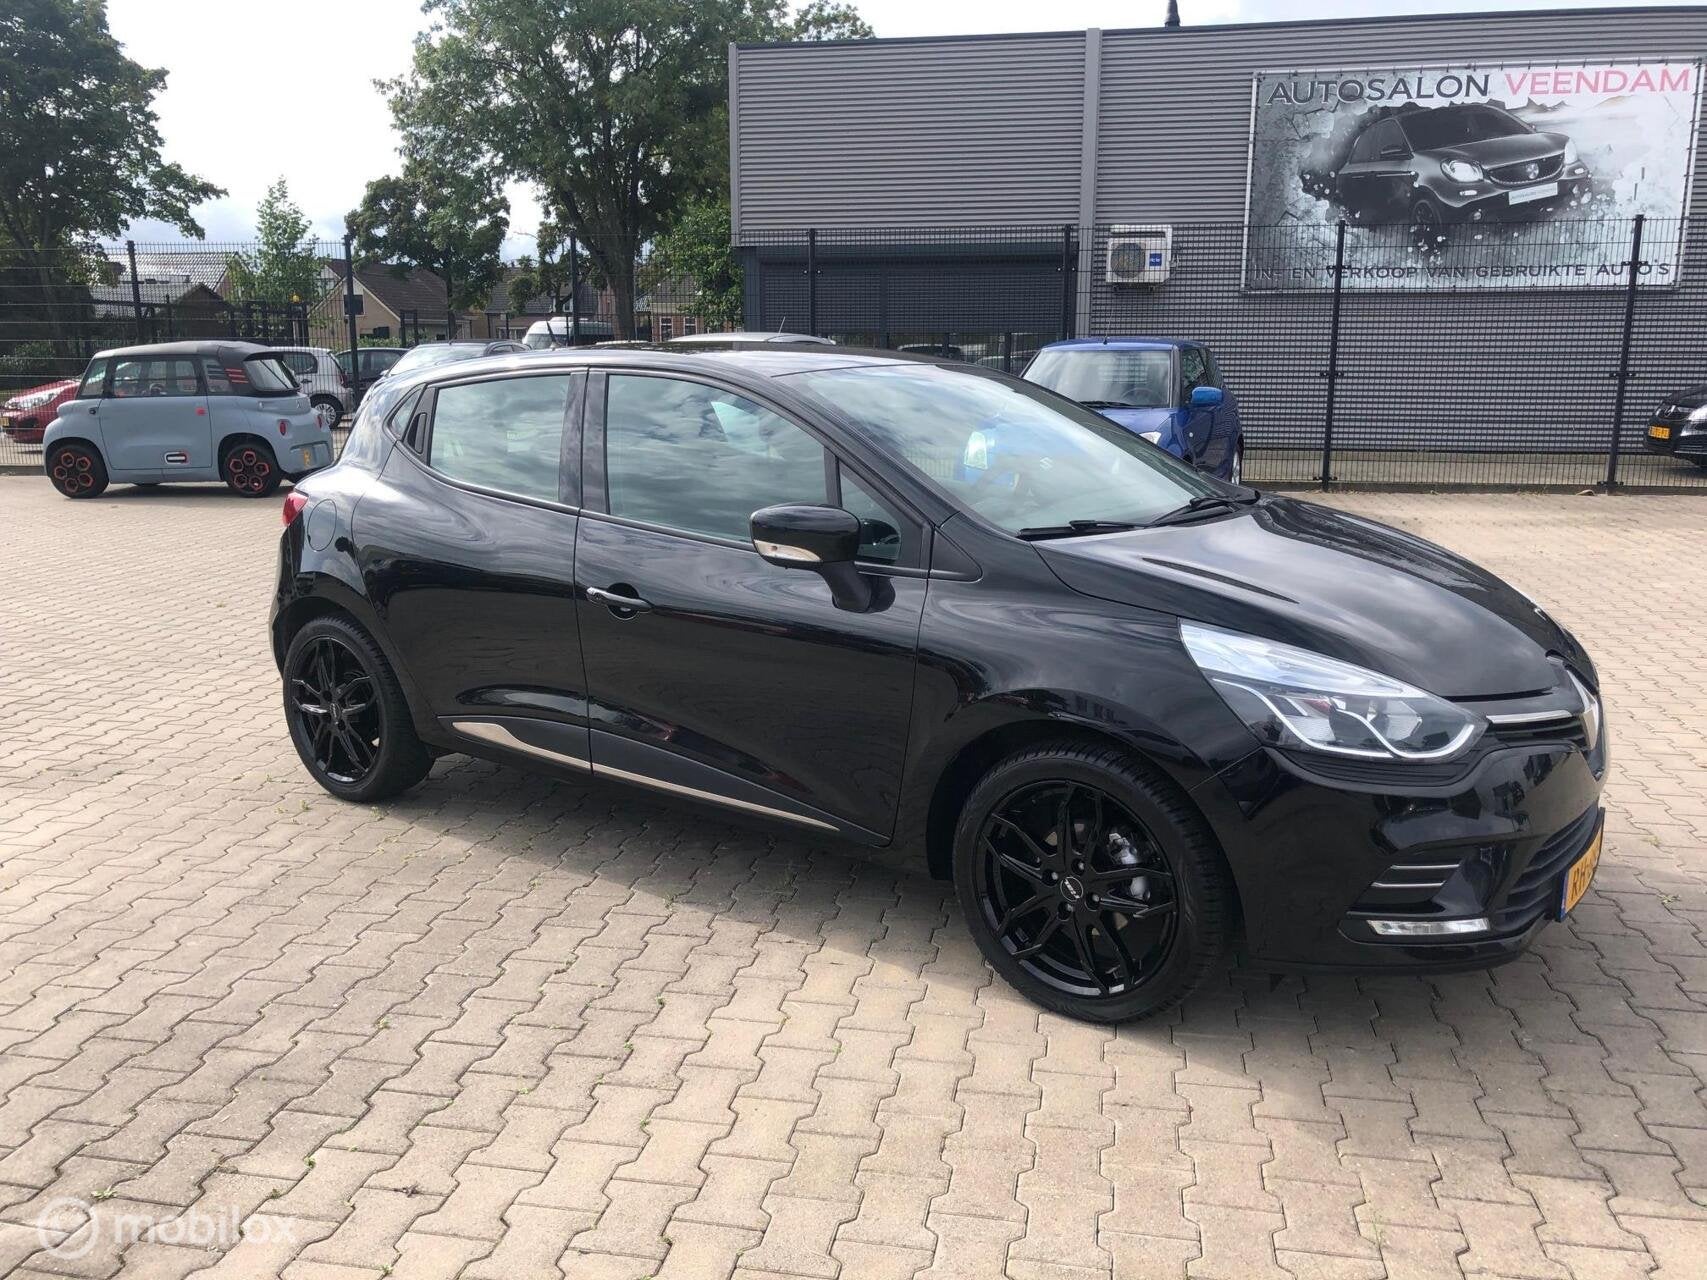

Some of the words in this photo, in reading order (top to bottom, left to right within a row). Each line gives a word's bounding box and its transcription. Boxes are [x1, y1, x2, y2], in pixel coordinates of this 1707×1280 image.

[1265, 74, 1490, 105] AUTOSALON
[1504, 68, 1690, 96] VEENDAM
[1291, 266, 1316, 279] EN
[1425, 266, 1466, 279] VAN
[1474, 263, 1588, 278] GEBRUIKTE
